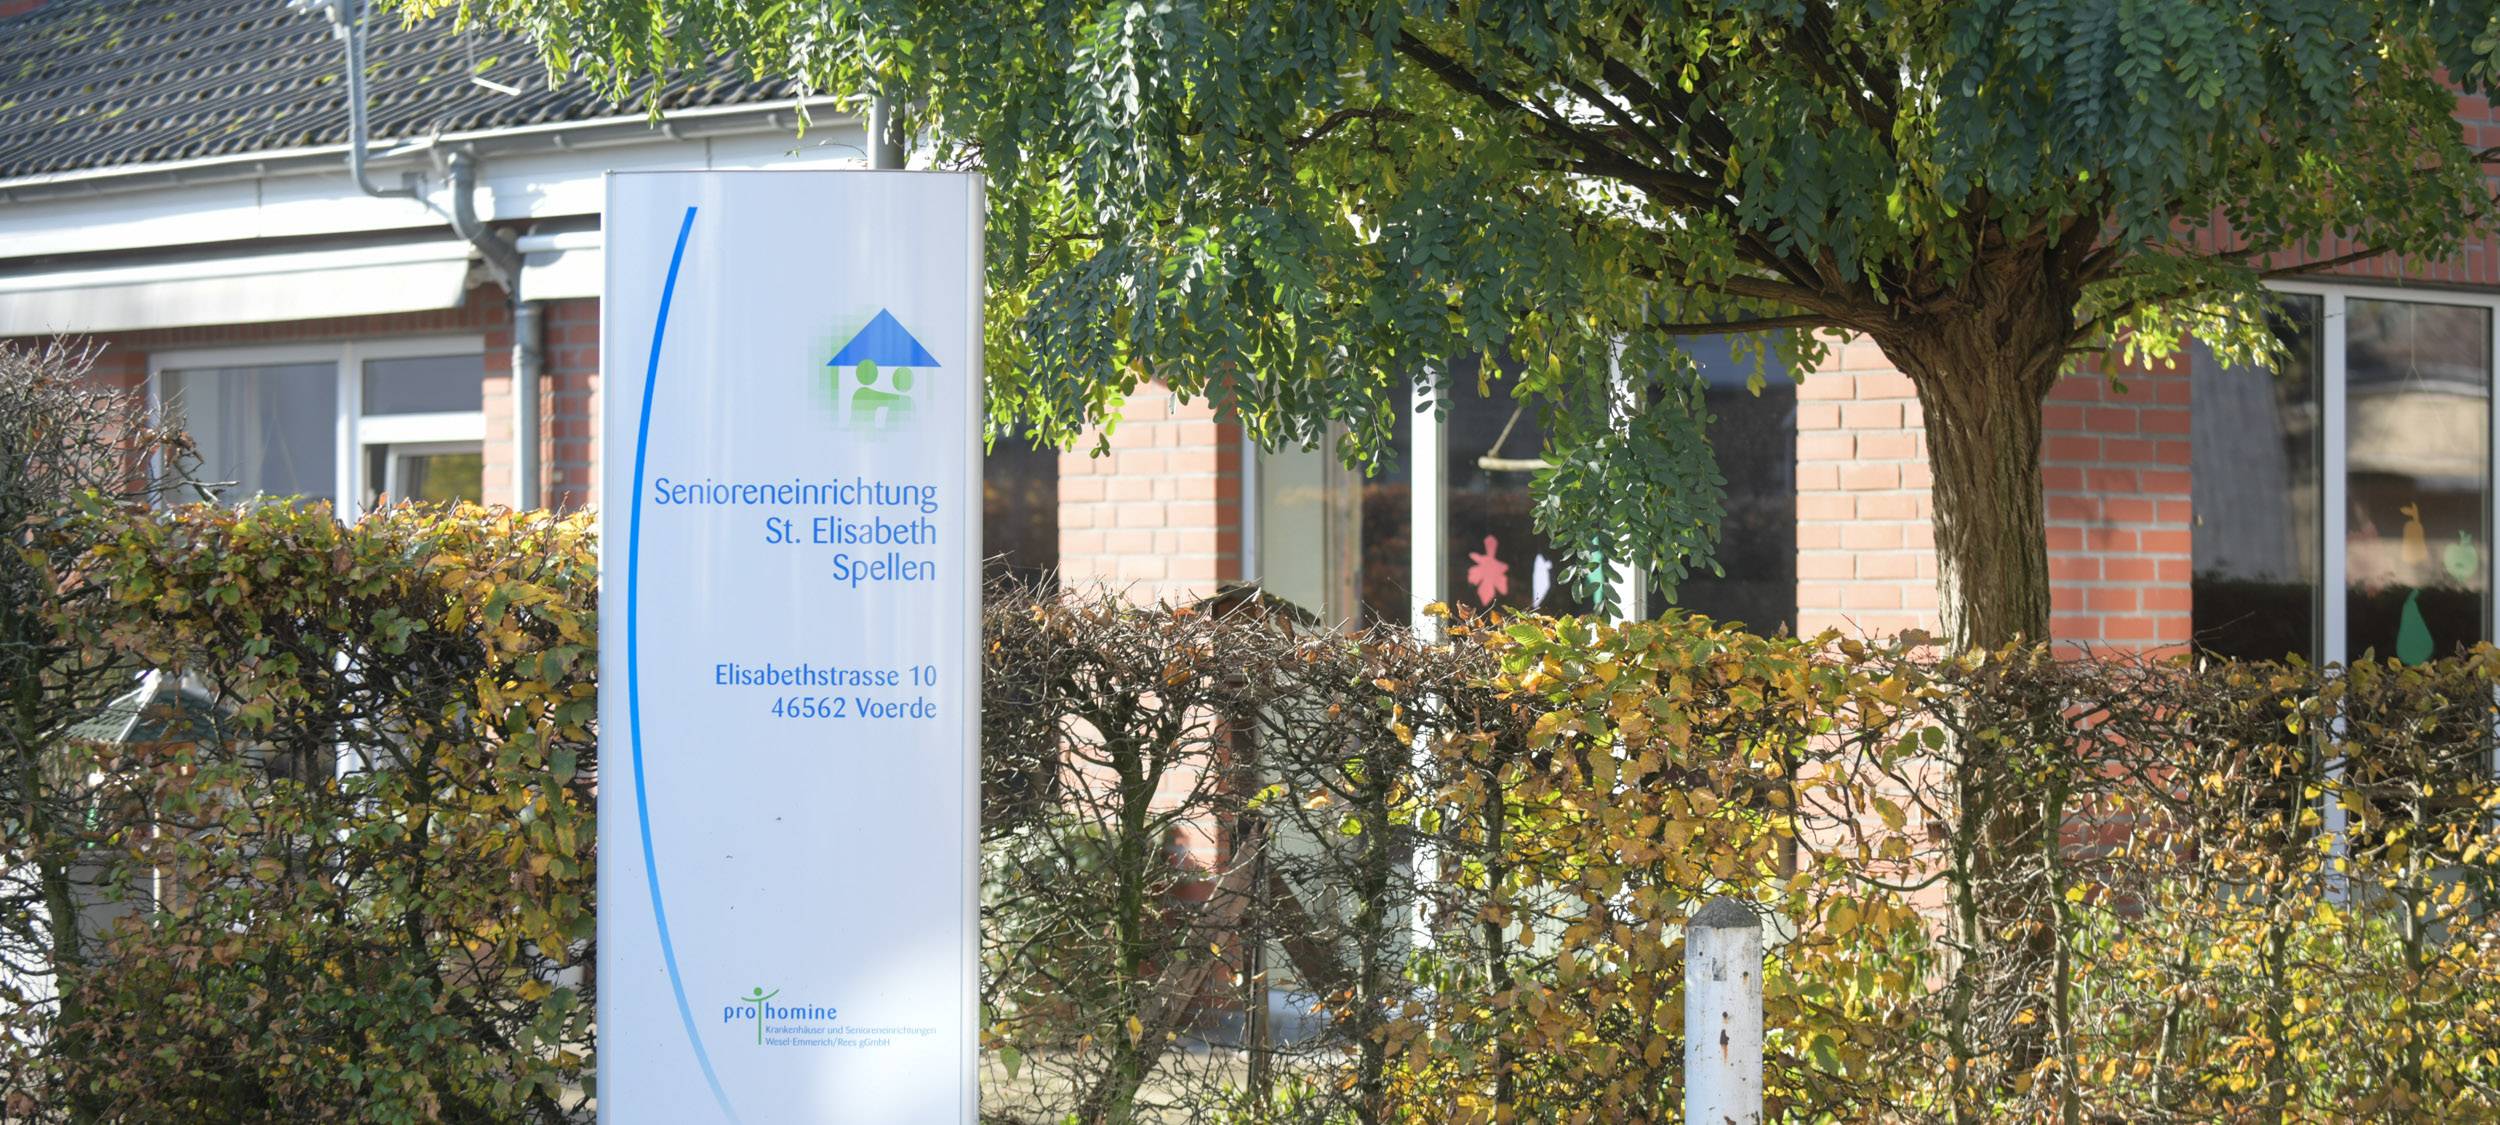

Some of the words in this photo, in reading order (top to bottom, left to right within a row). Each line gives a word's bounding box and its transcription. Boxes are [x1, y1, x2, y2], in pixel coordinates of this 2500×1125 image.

[654, 477, 939, 513] Senioreneinrichtung
[765, 517, 801, 545] St.
[812, 516, 937, 545] Elisabeth
[832, 553, 936, 588] Spellen
[715, 663, 900, 686] Elisabethstrasse
[909, 665, 937, 686] 10
[771, 697, 846, 718] 46562
[856, 697, 937, 718] Voerde
[765, 1025, 825, 1035] Krankenhäuser
[827, 1025, 844, 1034] und
[845, 1026, 937, 1037] Senioreneinrichtungen
[859, 1038, 890, 1048] gGmbH
